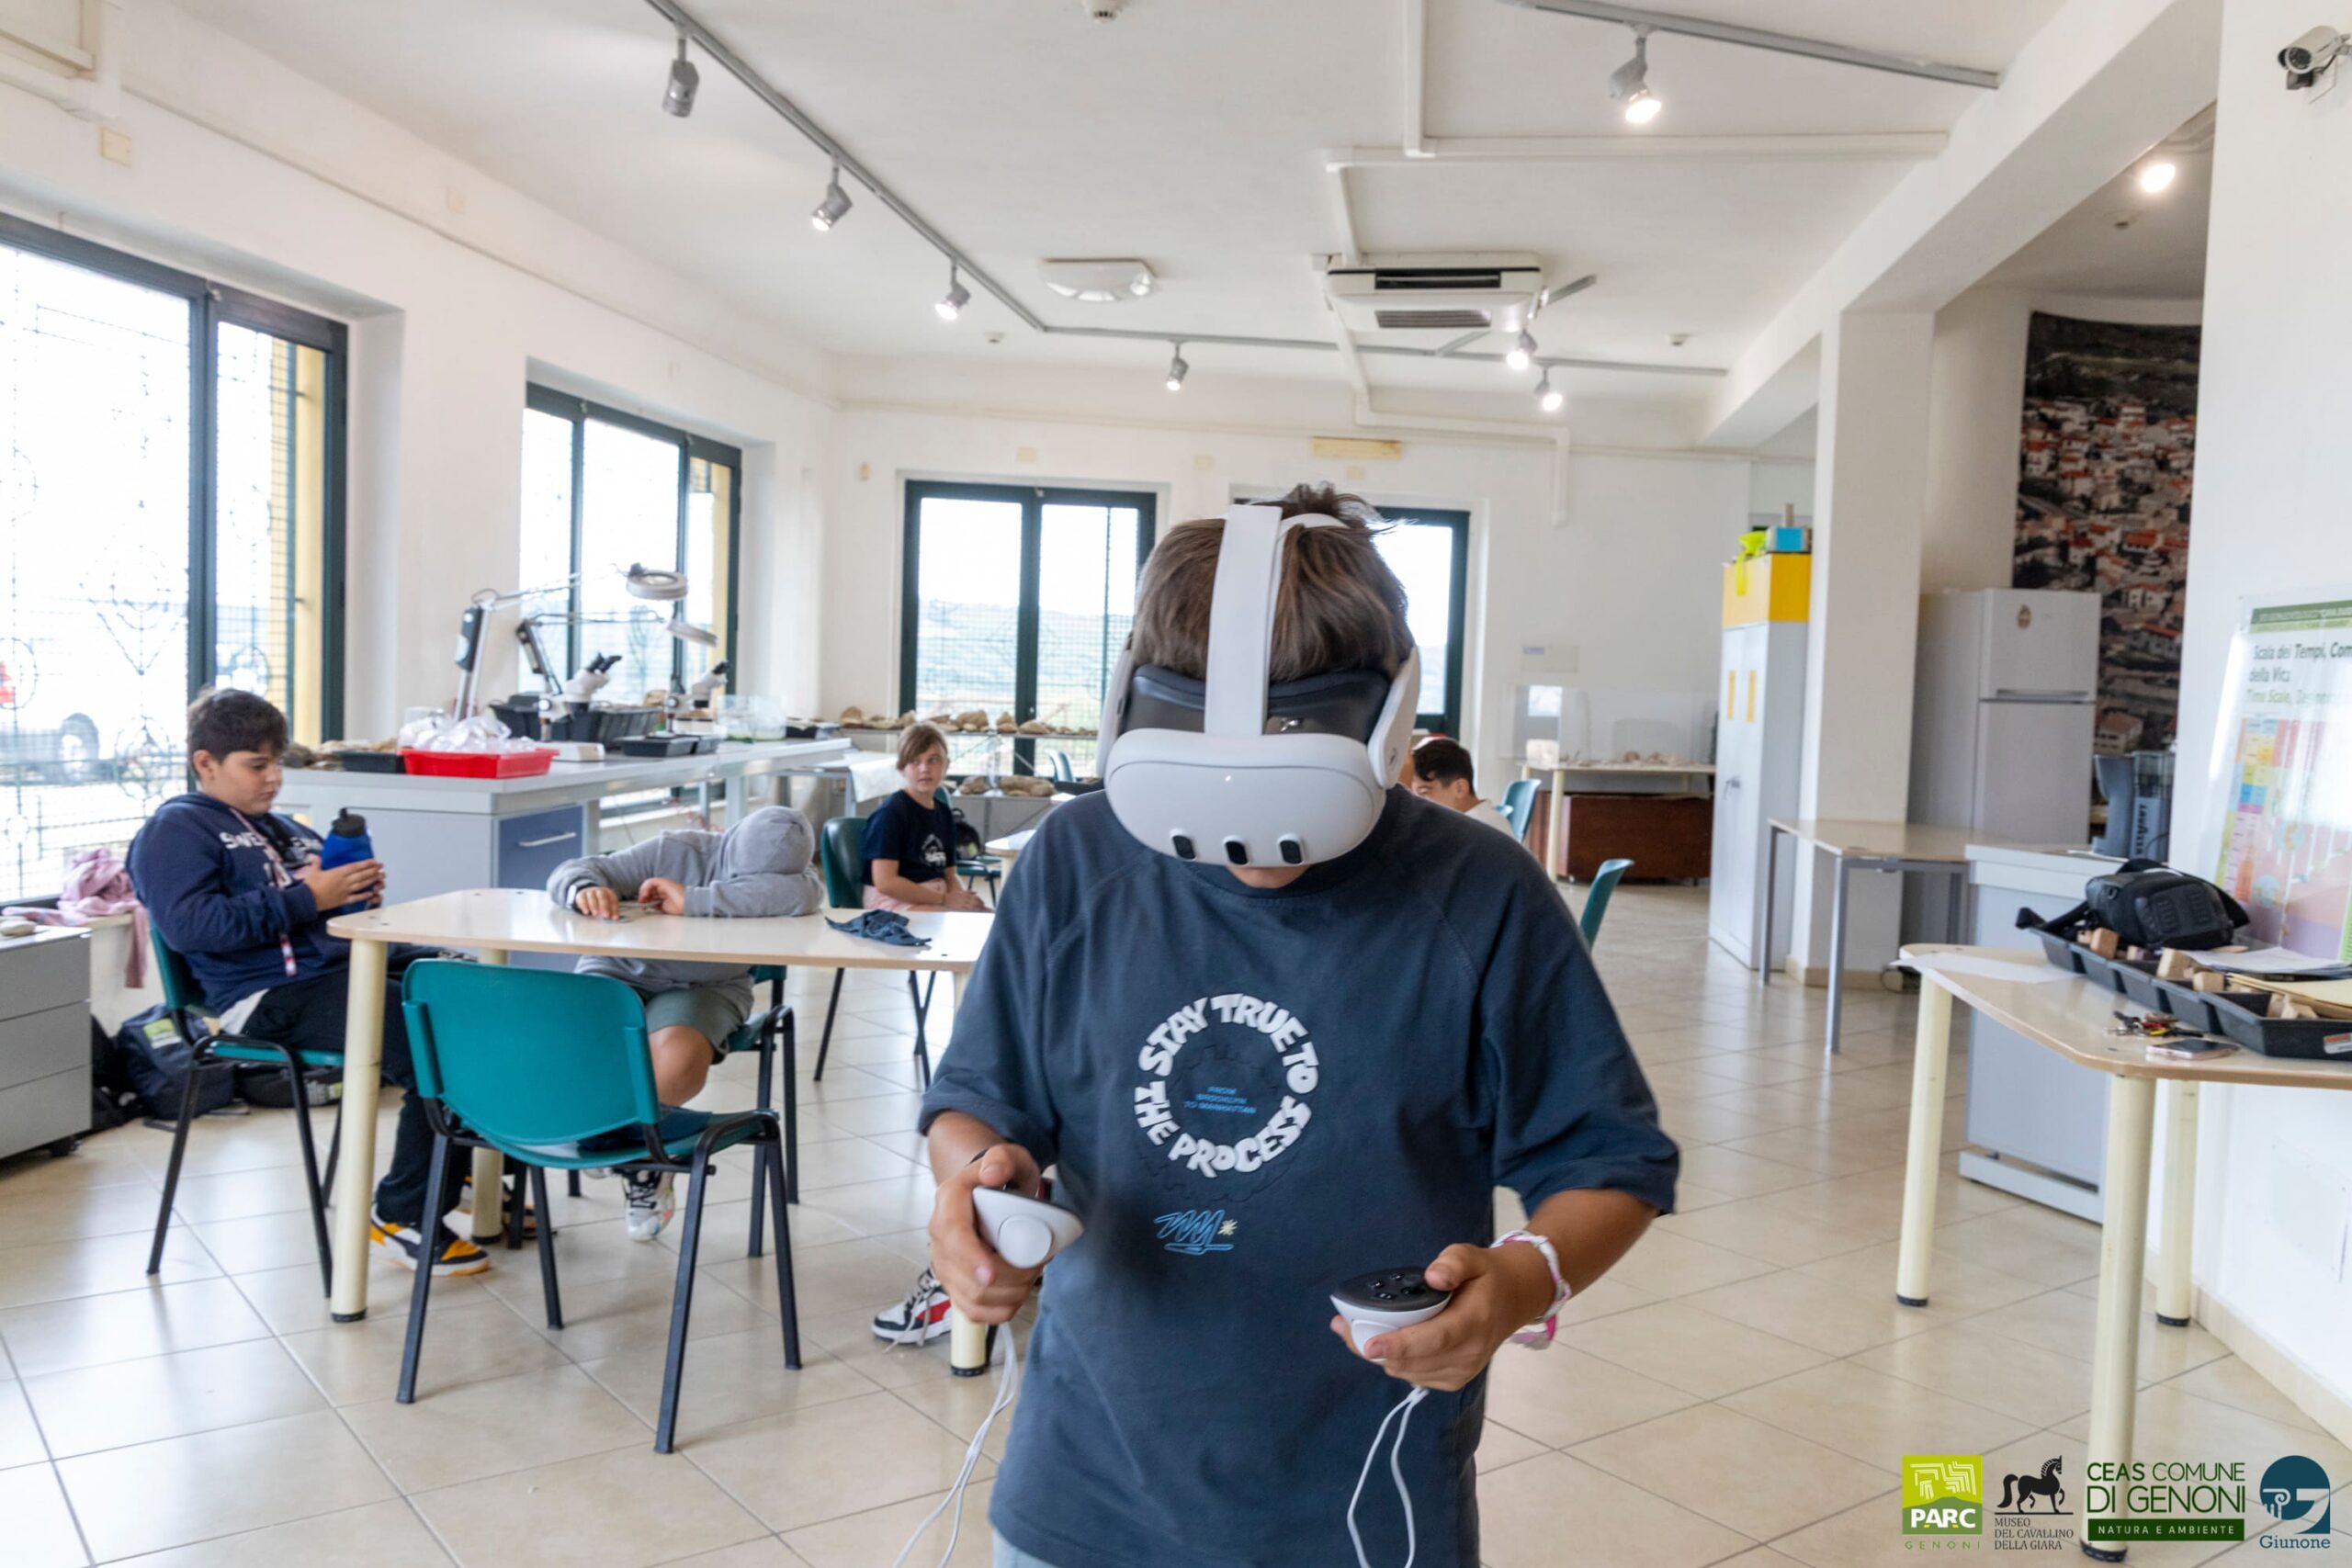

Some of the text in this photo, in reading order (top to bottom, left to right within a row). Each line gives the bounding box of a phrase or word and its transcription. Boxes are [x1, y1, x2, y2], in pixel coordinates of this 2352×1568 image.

[2253, 644, 2275, 660] Scala
[2276, 643, 2292, 660] dei
[1138, 993, 1320, 1095] STAY TRUE TO
[1134, 1080, 1312, 1179] THE PROCESS
